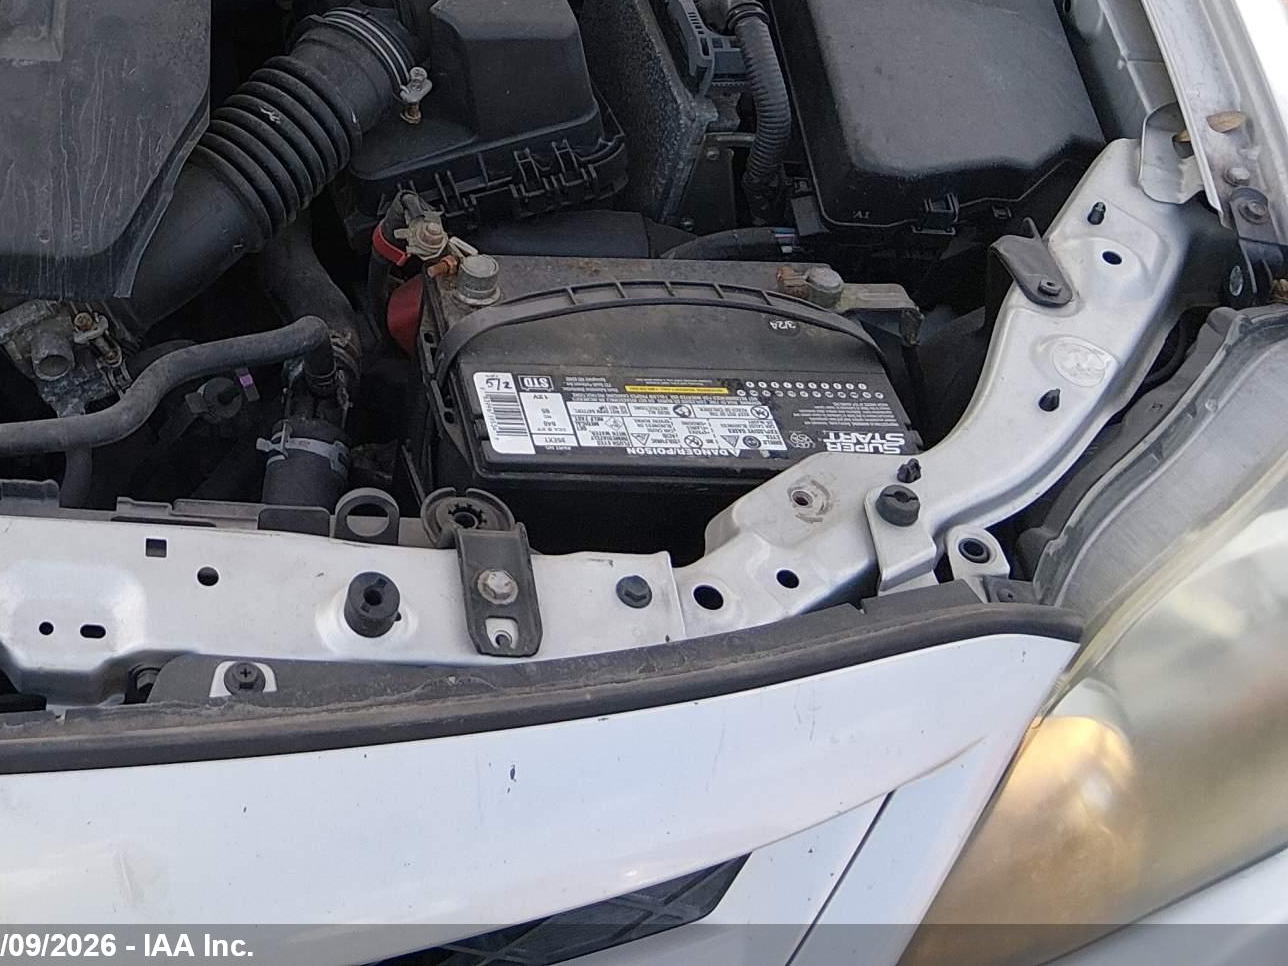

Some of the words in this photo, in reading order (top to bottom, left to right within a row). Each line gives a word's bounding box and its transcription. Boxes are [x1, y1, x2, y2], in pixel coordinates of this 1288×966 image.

[523, 378, 549, 388] STD
[822, 432, 905, 443] START
[626, 447, 729, 456] DANGER/POISON
[826, 442, 901, 454] SUPER
